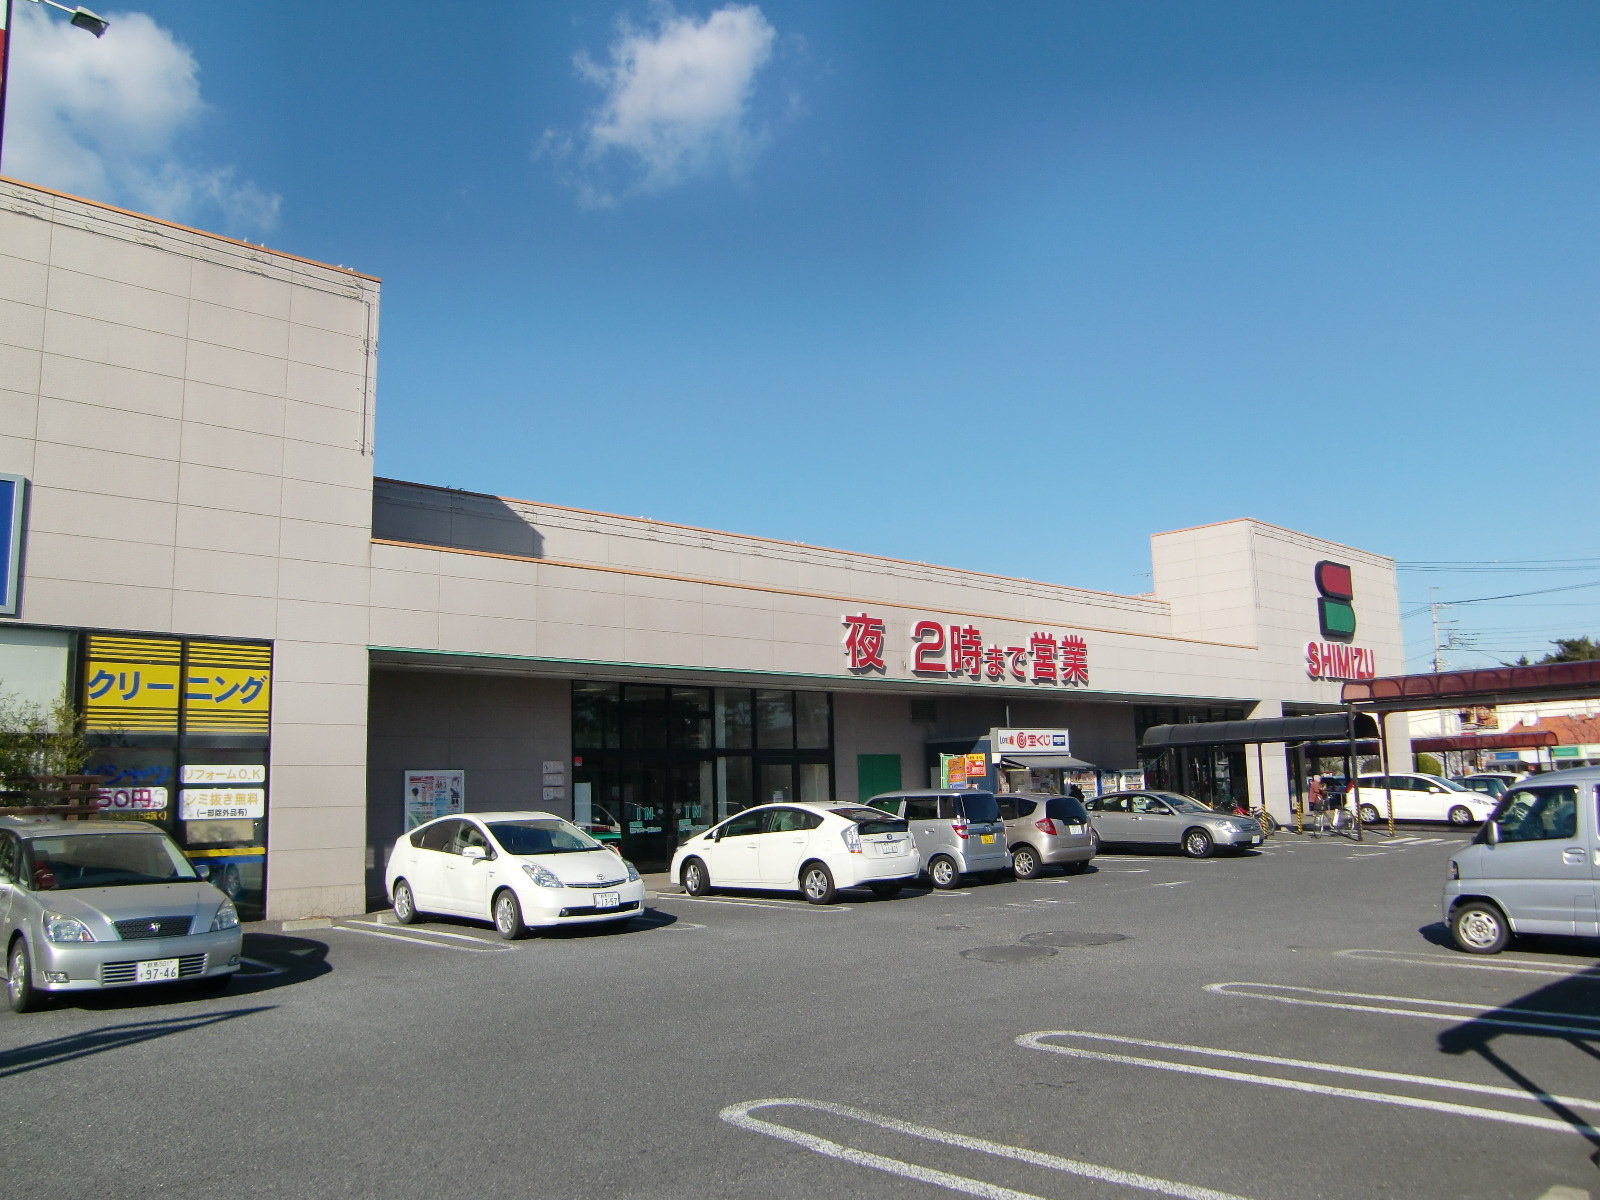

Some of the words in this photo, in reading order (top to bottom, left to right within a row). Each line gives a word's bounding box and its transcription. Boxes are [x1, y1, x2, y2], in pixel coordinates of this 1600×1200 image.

[841, 612, 884, 670] 夜
[910, 620, 1089, 682] 2時まで営業
[1304, 641, 1376, 680] SHIMIZU
[87, 669, 269, 706] クリーニング
[1028, 734, 1051, 747] 宝くじ
[184, 792, 259, 806] シミ抜き無料
